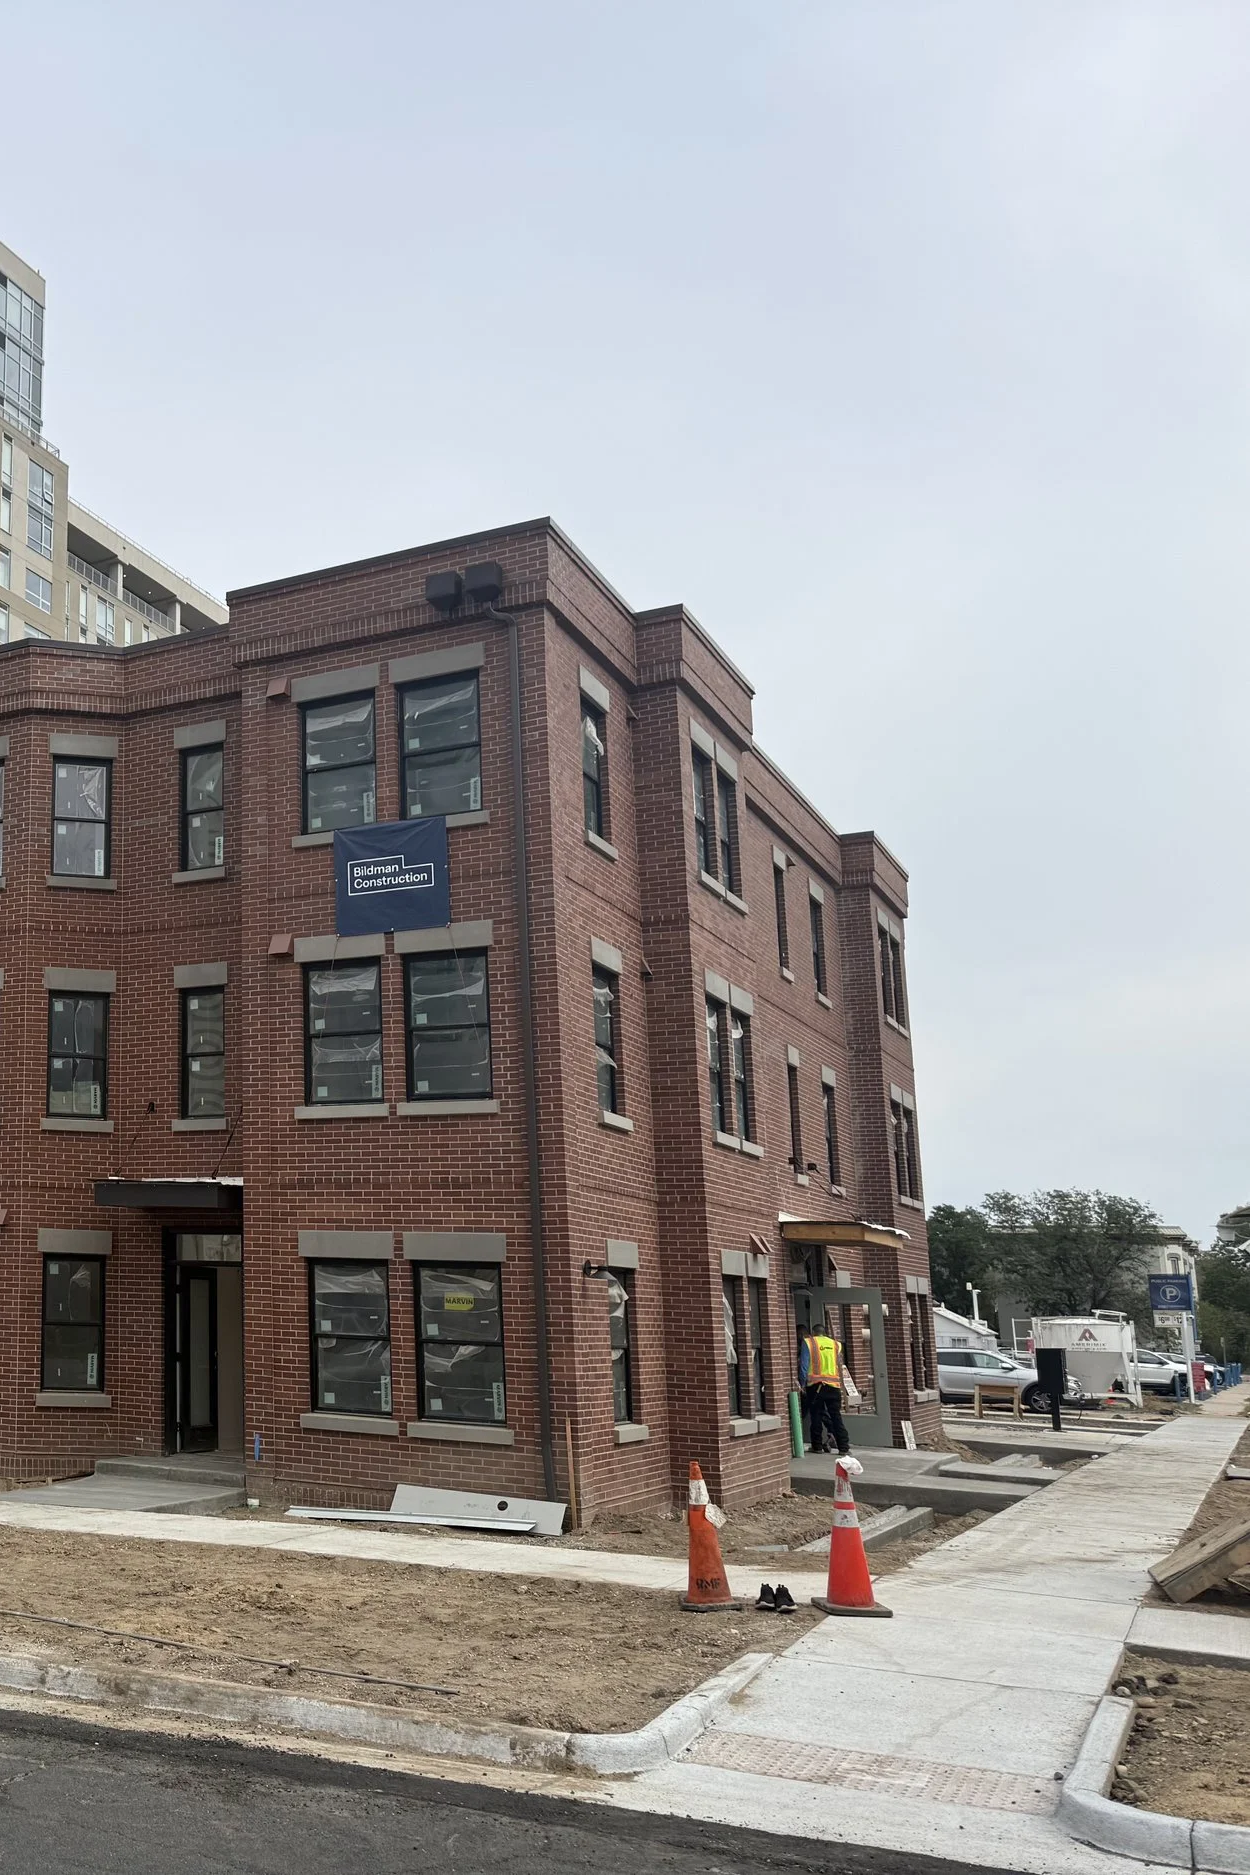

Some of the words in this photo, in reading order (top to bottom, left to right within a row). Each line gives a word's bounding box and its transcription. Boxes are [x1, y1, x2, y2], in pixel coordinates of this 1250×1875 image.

[353, 865, 399, 877] Bildman
[353, 872, 428, 889] Construction
[445, 1296, 473, 1305] MARVIN
